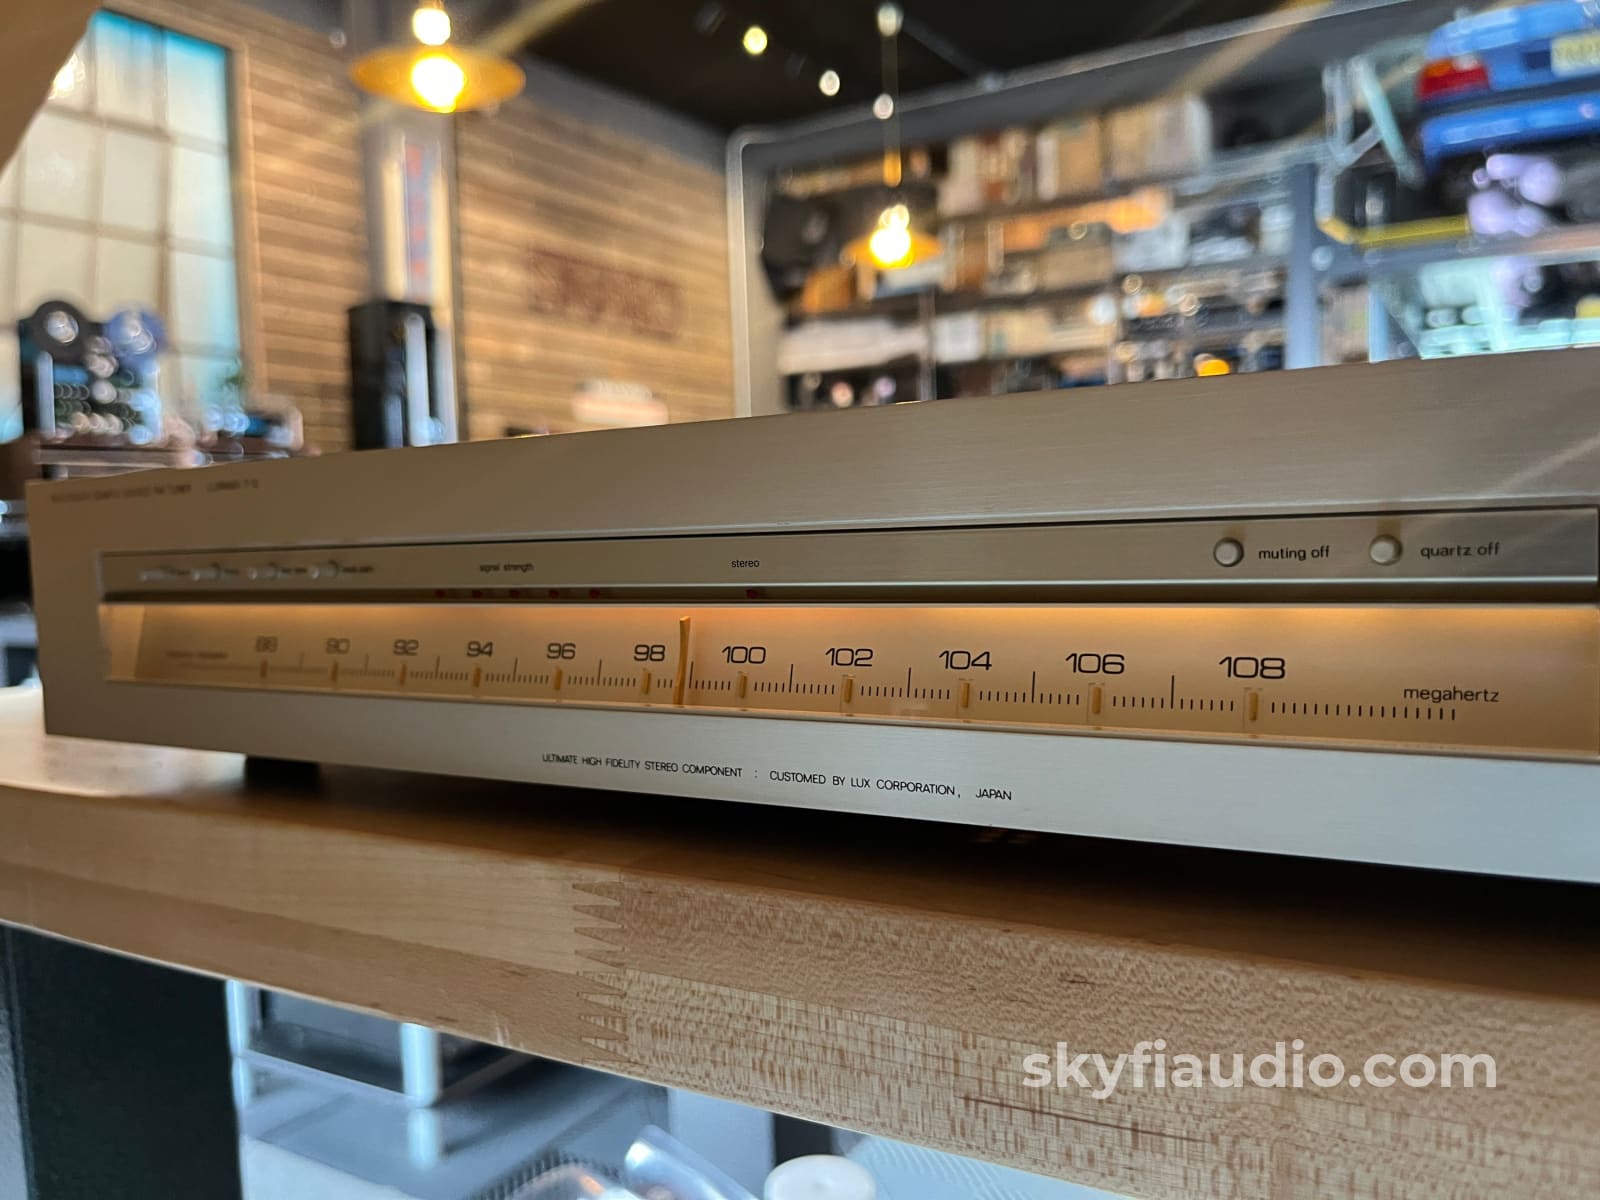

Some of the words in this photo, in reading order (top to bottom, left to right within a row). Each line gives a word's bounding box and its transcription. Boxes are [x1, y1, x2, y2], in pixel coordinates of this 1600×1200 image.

[1258, 546, 1306, 561] muting
[1311, 545, 1330, 559] off
[1420, 543, 1472, 559] quartz
[1477, 541, 1500, 556] off
[731, 559, 760, 569] stereo
[326, 637, 350, 655] 90
[393, 639, 420, 656] 92
[466, 641, 493, 657] 94
[546, 643, 576, 660] 96
[634, 644, 666, 662] 98
[721, 645, 766, 665] 100
[825, 647, 874, 667] 102
[938, 650, 992, 671] 104
[1065, 652, 1125, 675] 106
[1218, 656, 1286, 680] 108
[1403, 685, 1499, 704] megahertz
[542, 753, 578, 765] ULTIMATE
[582, 757, 602, 766] HIGH
[605, 758, 640, 769] FIDELITY
[644, 760, 678, 773] STEREO
[682, 763, 743, 778] COMPONENT
[769, 770, 826, 785] CUSTOMED
[832, 776, 846, 786] BY
[850, 777, 871, 789] LUX
[975, 788, 1012, 801] JAPAN
